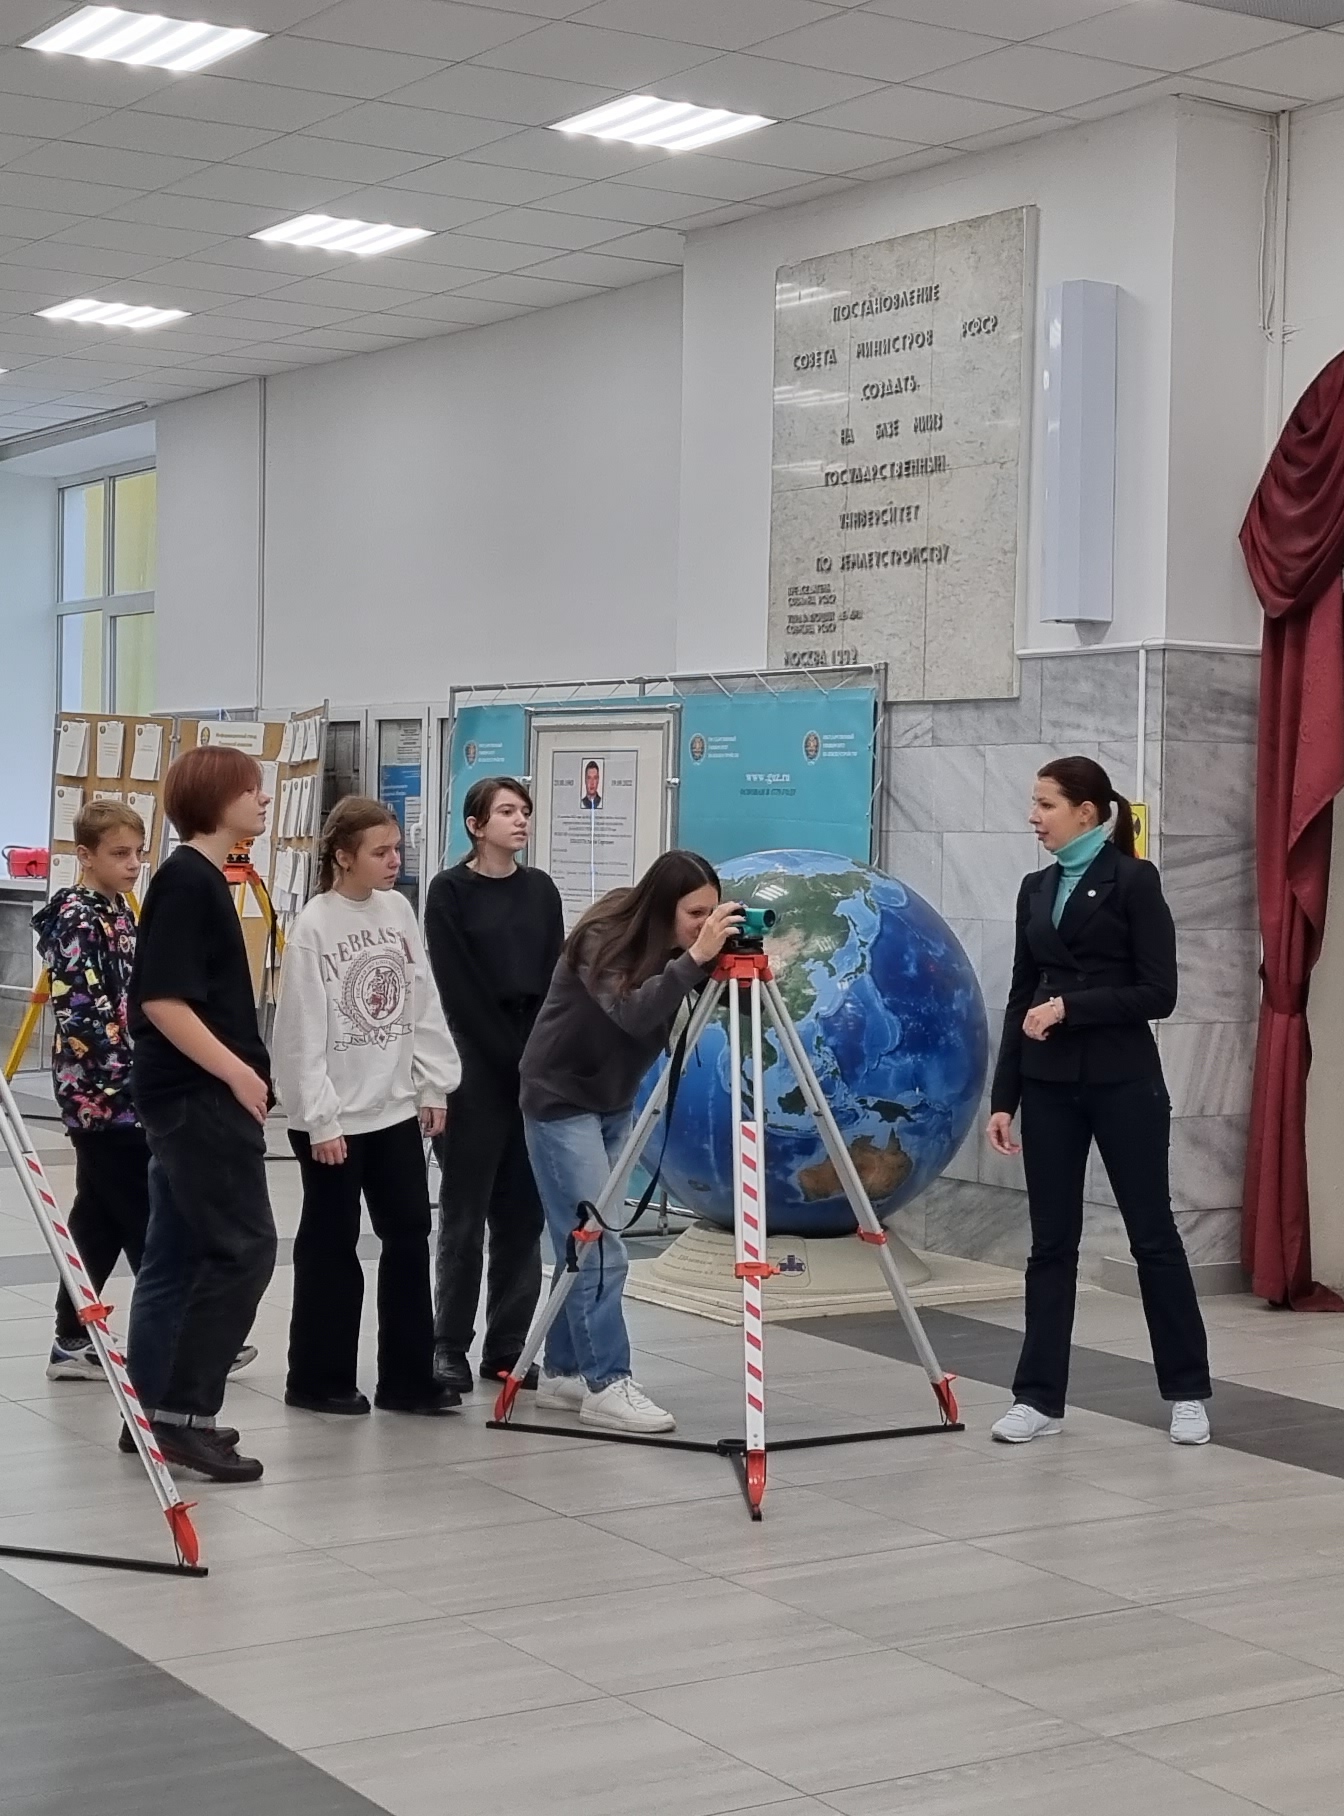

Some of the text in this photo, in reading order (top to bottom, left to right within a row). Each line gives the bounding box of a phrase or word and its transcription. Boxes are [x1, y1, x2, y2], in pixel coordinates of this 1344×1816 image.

[833, 284, 940, 322] ПОСТАНОВЛЕНИЕ
[793, 315, 998, 371] СОВЕТА МИНИСТРОВ РСФСР
[841, 428, 855, 446] НА
[876, 419, 900, 440] БАЗЕ
[840, 504, 920, 530] УНИВЕРСИТЕТ
[816, 556, 832, 573] ПО
